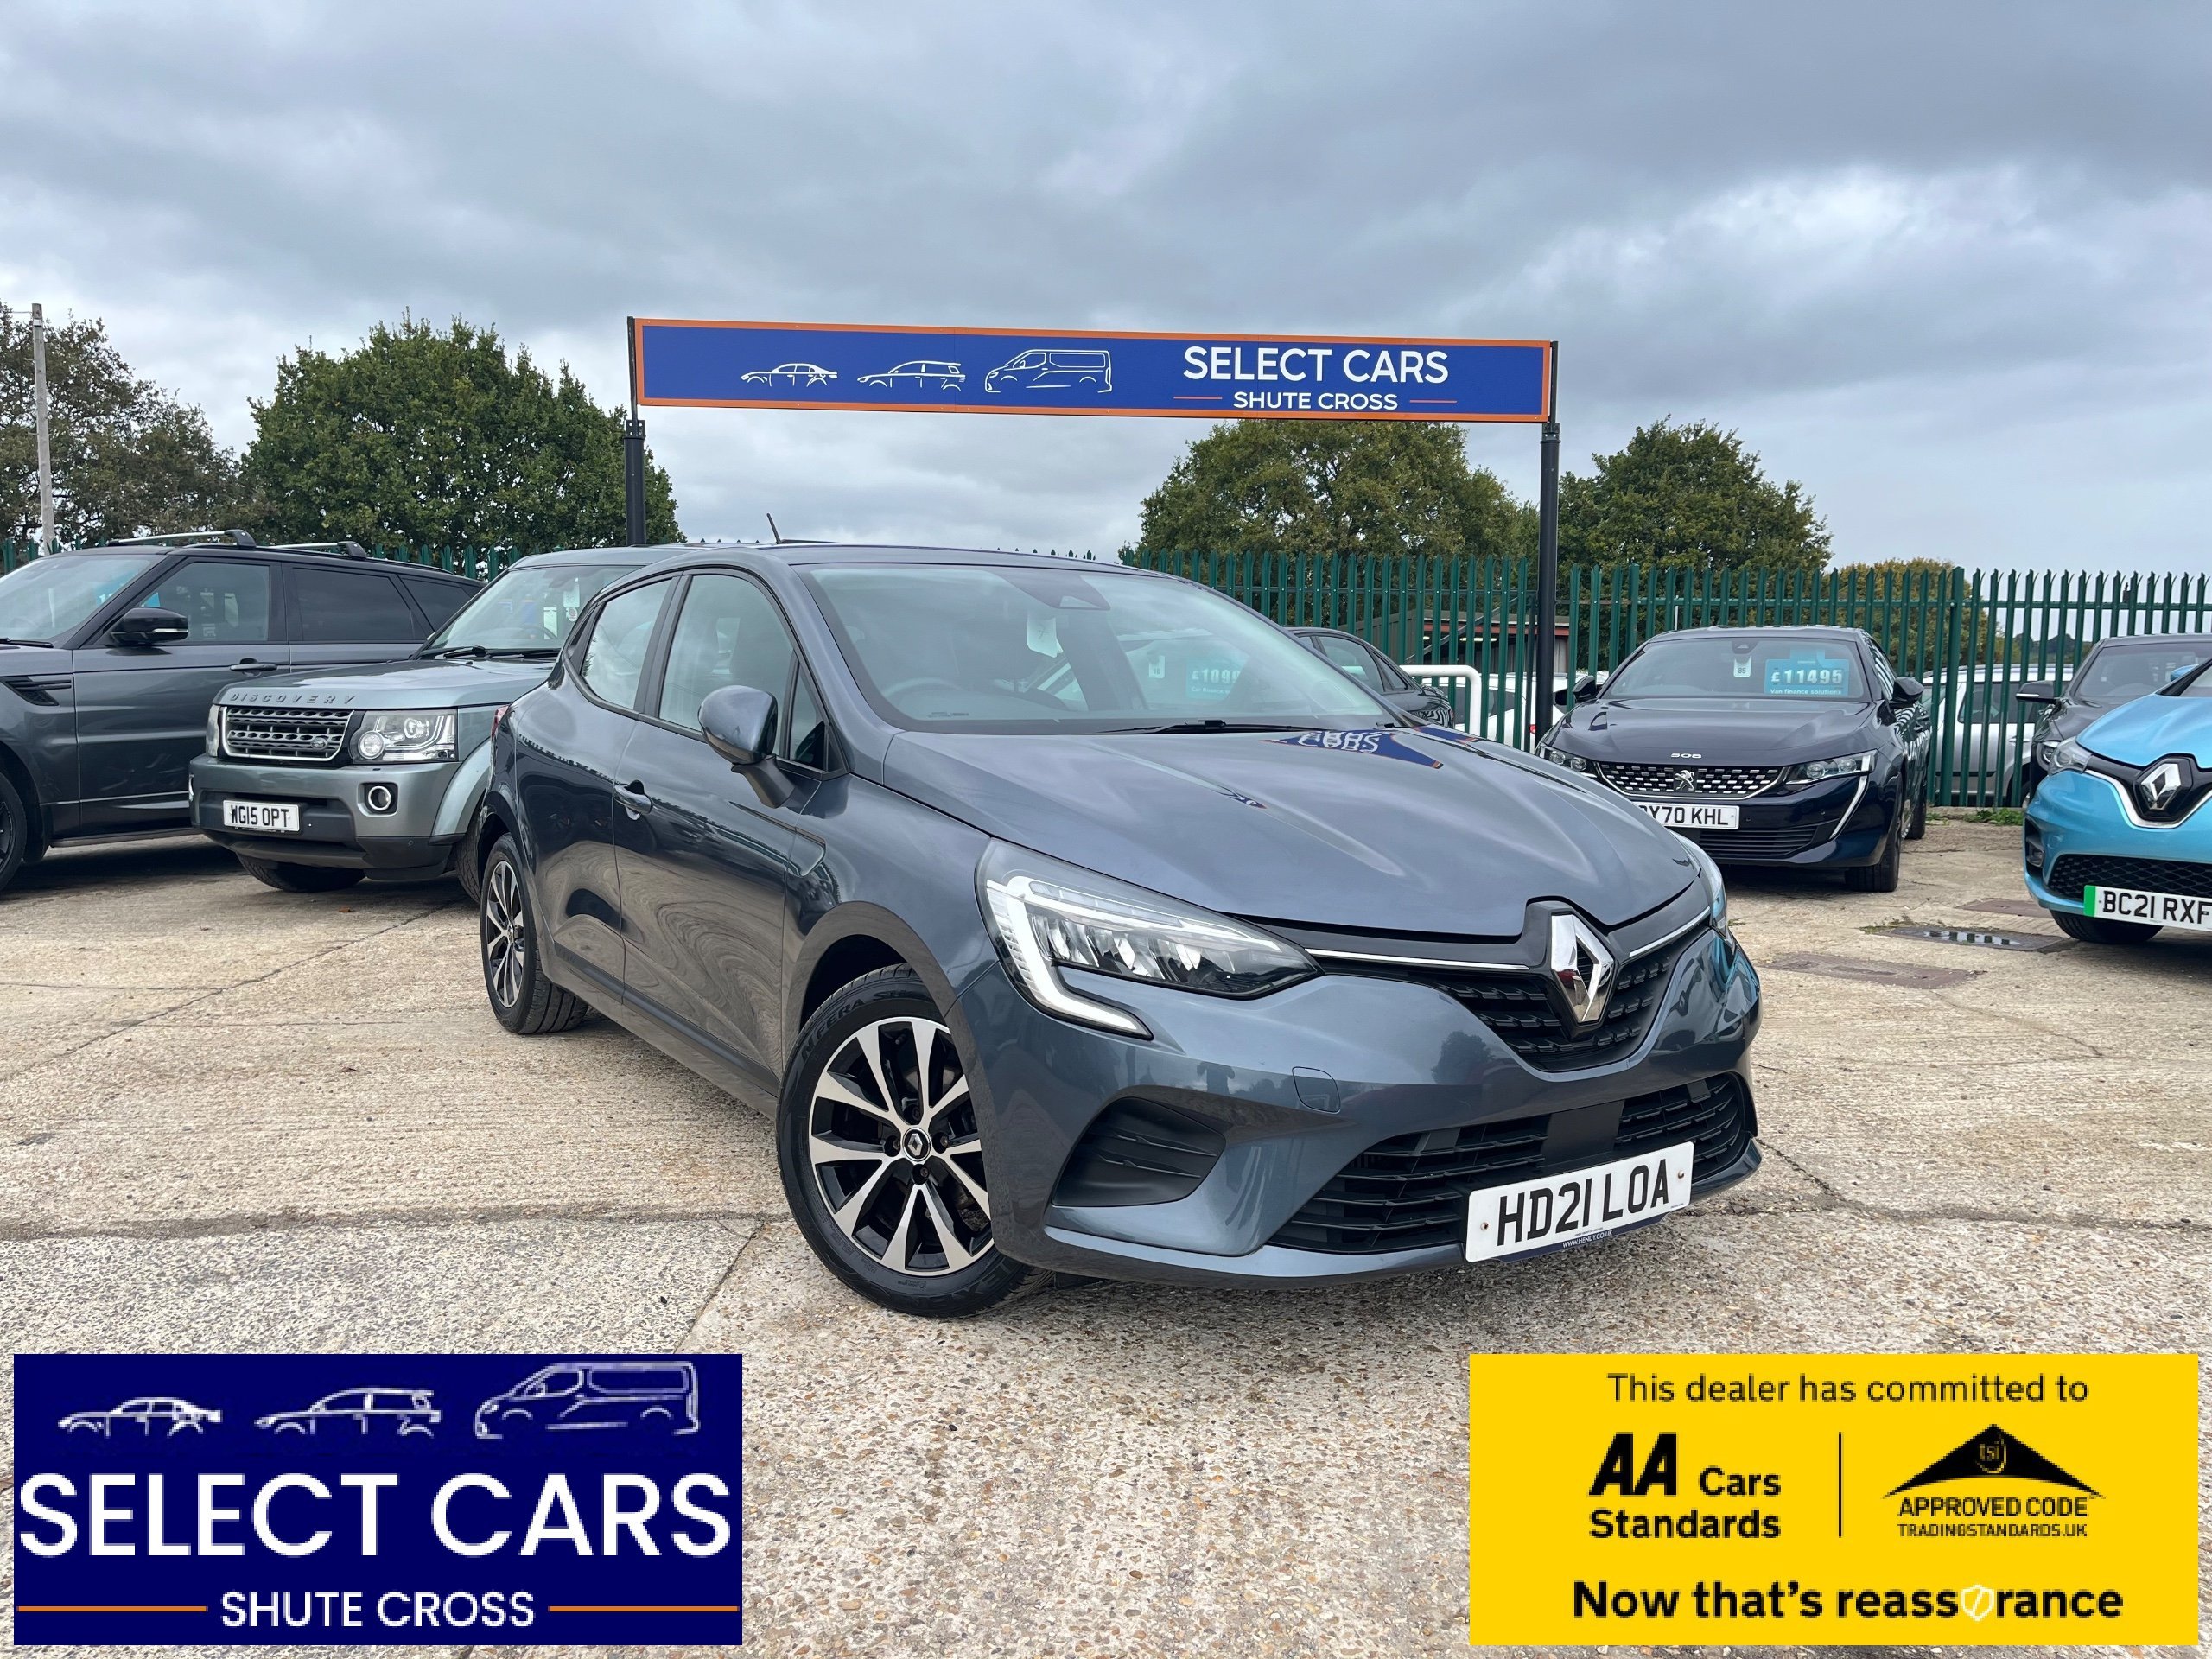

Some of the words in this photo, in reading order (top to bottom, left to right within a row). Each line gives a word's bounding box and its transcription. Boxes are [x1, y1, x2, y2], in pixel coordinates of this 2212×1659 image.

[1183, 346, 1332, 381] SELECT
[1343, 349, 1449, 384] CARS
[1233, 391, 1312, 409] SHUTE
[1318, 392, 1398, 410] CROSS
[229, 693, 357, 705] DISCOVERY
[231, 804, 258, 825] WG15
[262, 807, 289, 828] OPT
[1691, 807, 1729, 825] KHL
[2102, 890, 2156, 918] BC21
[2163, 897, 2212, 924] RXF
[1497, 1177, 1592, 1247] HD21
[1602, 1158, 1669, 1223] LOA
[1561, 1230, 1614, 1249] WWW.HENDY.CO.UK
